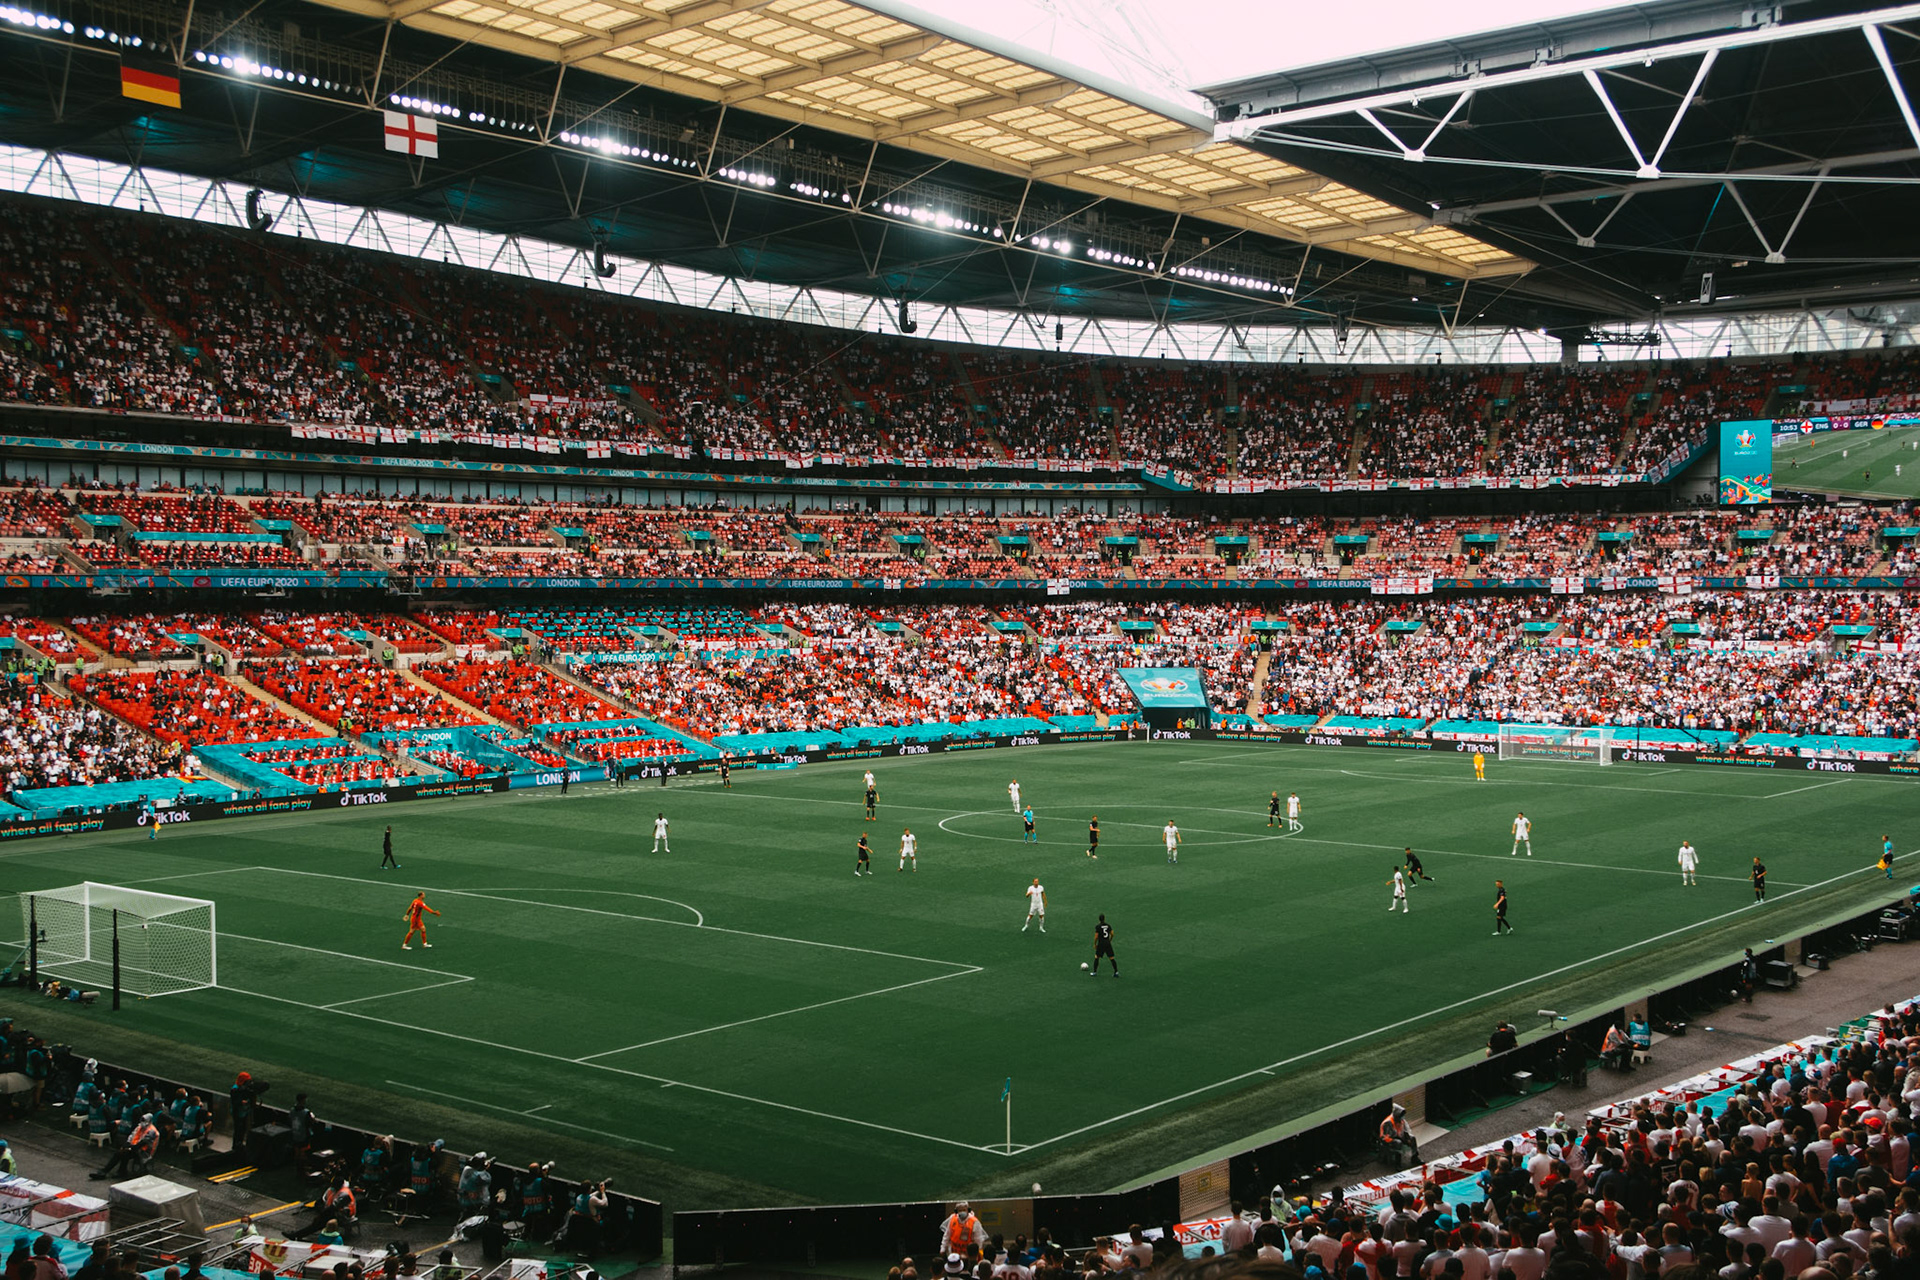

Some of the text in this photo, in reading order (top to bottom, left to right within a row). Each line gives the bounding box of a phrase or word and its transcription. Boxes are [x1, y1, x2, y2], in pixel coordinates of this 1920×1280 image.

[141, 444, 174, 454] LONDON
[381, 457, 434, 468] UEFA EURO 2020
[610, 470, 635, 478] LONDON
[221, 577, 299, 587] UEFA EURO 2020
[546, 579, 580, 588] LONDON
[788, 580, 807, 588] UEFA
[808, 580, 825, 588] EURO
[1317, 580, 1338, 588] UEFA
[1340, 580, 1361, 588] EURO
[1627, 579, 1658, 588] LONDO
[619, 653, 637, 662] EURO
[421, 732, 452, 741] ONDON
[1162, 731, 1191, 741] TikTok
[1216, 732, 1238, 741] where
[1314, 736, 1342, 746] TikTok
[1018, 737, 1039, 747] TikTok
[1367, 739, 1389, 748] where
[907, 745, 930, 755] TikTok
[1467, 743, 1496, 755] TikTok
[784, 754, 808, 765] TikTok
[1696, 754, 1776, 768] where all fans play
[650, 764, 678, 778] Tikok
[1819, 761, 1855, 772] TikTok
[1889, 763, 1920, 774] where
[416, 781, 493, 797] where all fans play
[352, 791, 388, 806] TikTok
[223, 798, 312, 815] where all fans play
[0, 817, 104, 837] where all fans play
